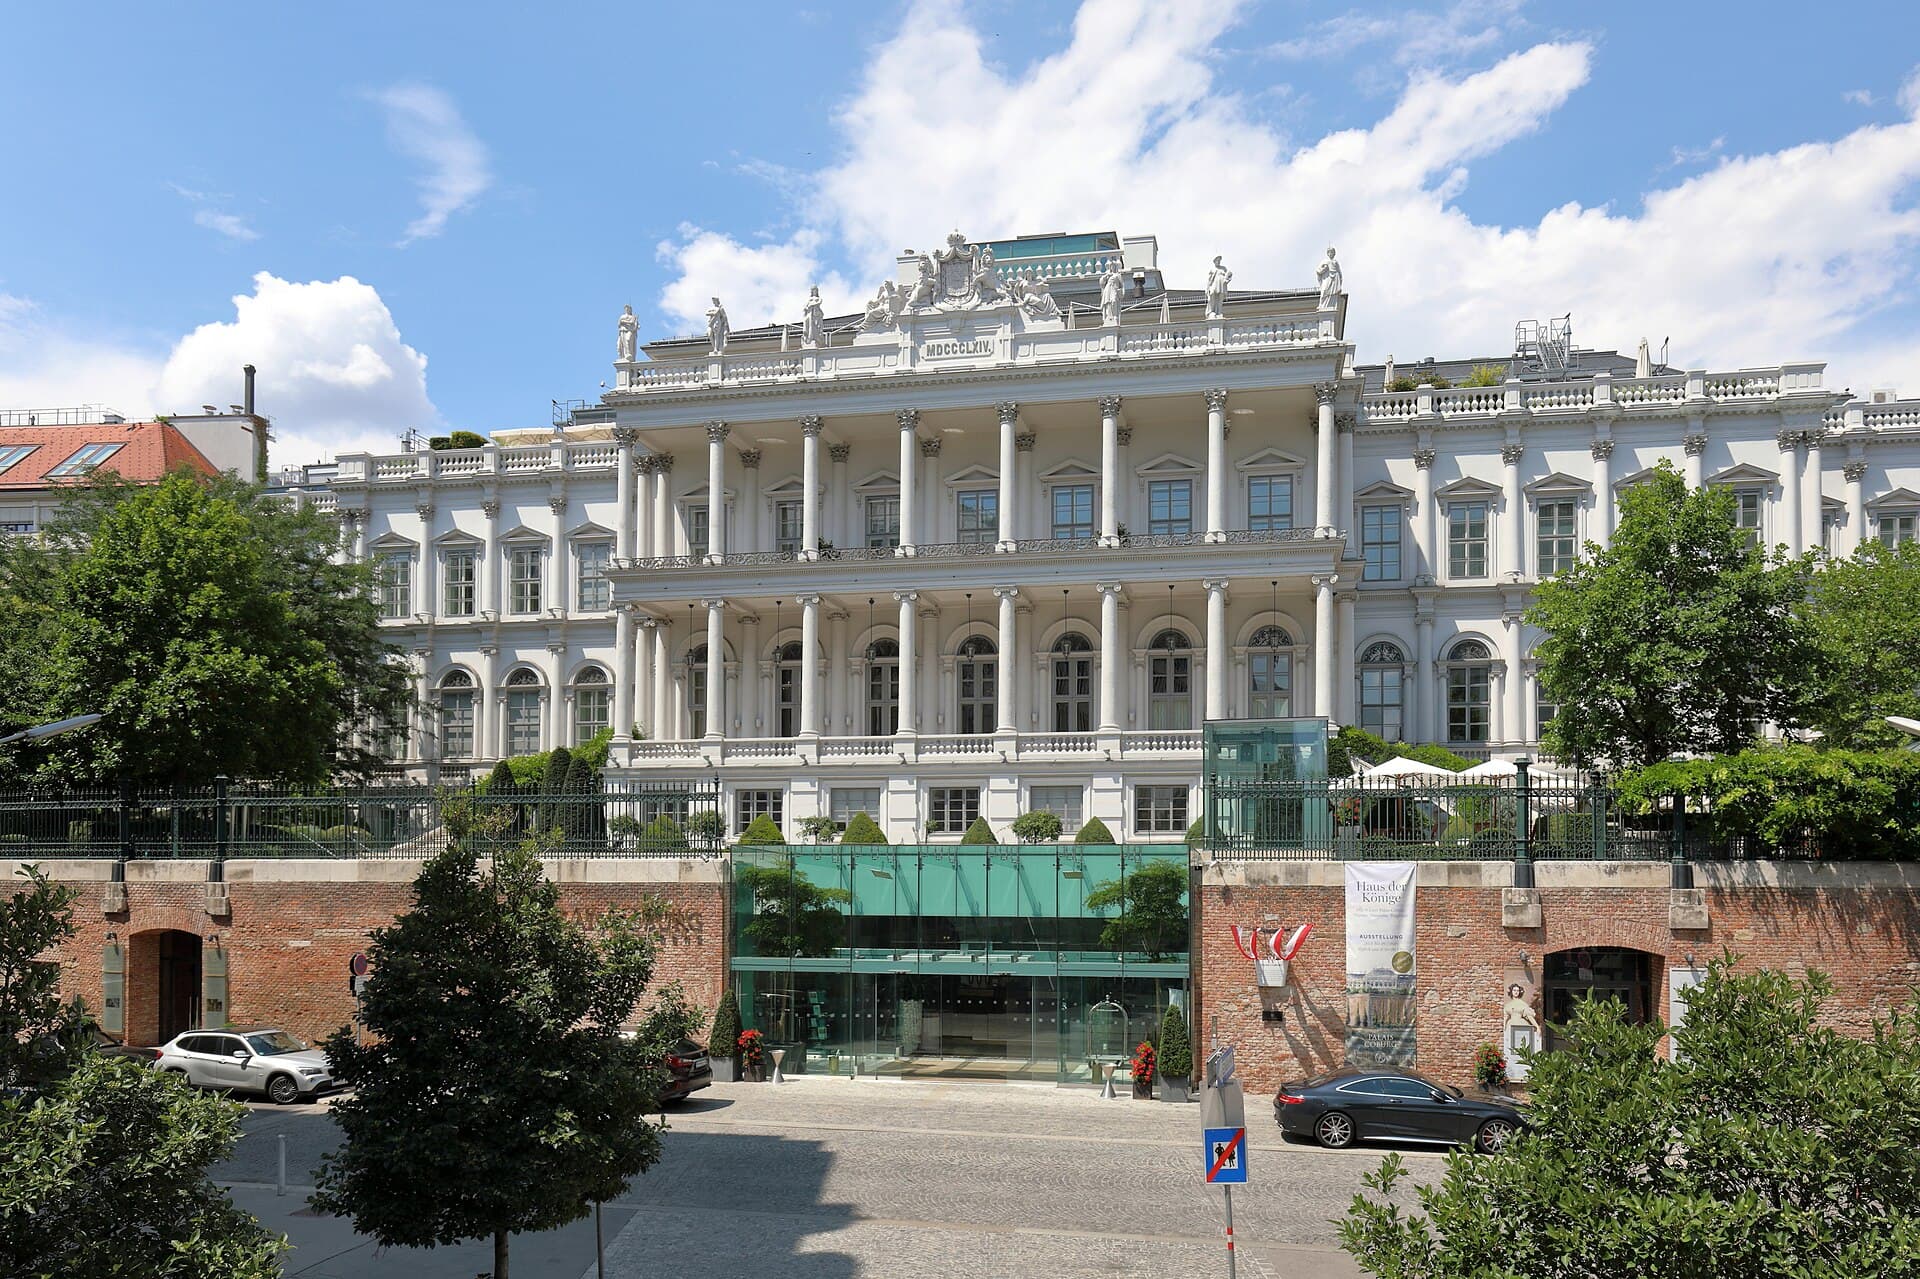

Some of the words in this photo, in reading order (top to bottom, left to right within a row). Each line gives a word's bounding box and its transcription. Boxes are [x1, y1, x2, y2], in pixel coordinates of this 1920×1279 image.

[926, 340, 991, 357] MDCCCLXIV.
[1356, 880, 1386, 892] Haus
[1388, 880, 1407, 892] der
[1362, 892, 1401, 905] Könige
[1368, 1033, 1394, 1041] PALAIS
[1364, 1040, 1397, 1048] COBURG
